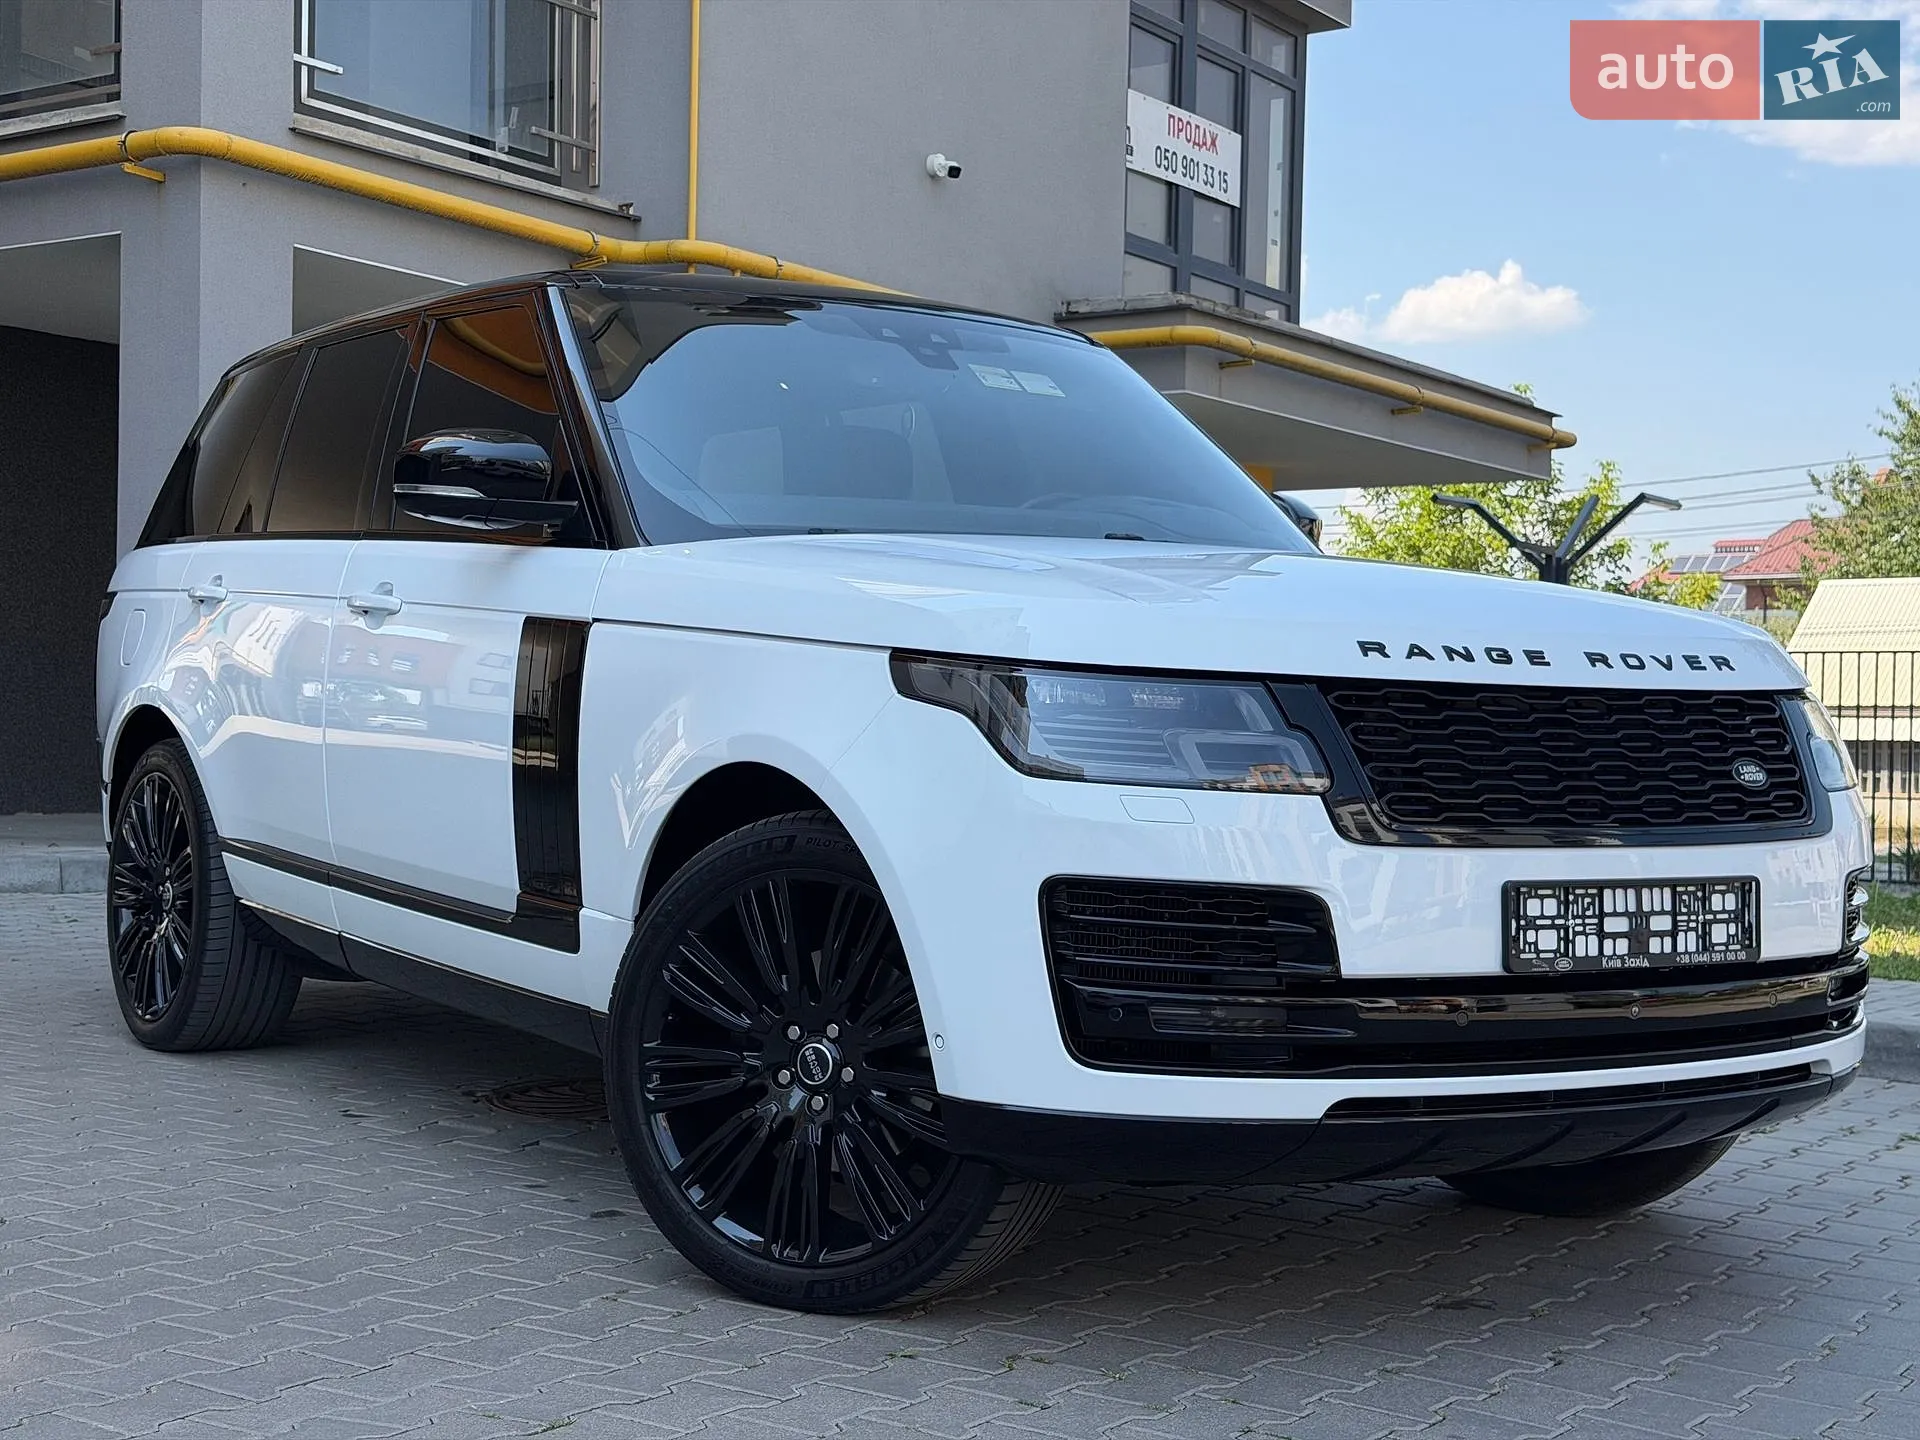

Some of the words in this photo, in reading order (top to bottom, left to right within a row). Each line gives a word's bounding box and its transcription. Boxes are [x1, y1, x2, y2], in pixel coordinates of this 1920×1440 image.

[1167, 113, 1219, 156] ПРОДАЖ
[1155, 145, 1177, 175] 050
[1181, 155, 1200, 183] 901
[1203, 163, 1215, 189] 33
[1218, 169, 1229, 194] 15
[1356, 640, 1551, 667] RANGE
[1583, 651, 1737, 672] ROVER
[1744, 773, 1763, 781] ROVER
[805, 837, 840, 849] PILOT
[1676, 954, 1690, 964] +38
[1691, 952, 1710, 964] (044)
[1726, 951, 1736, 961] 00
[1736, 951, 1746, 960] 00
